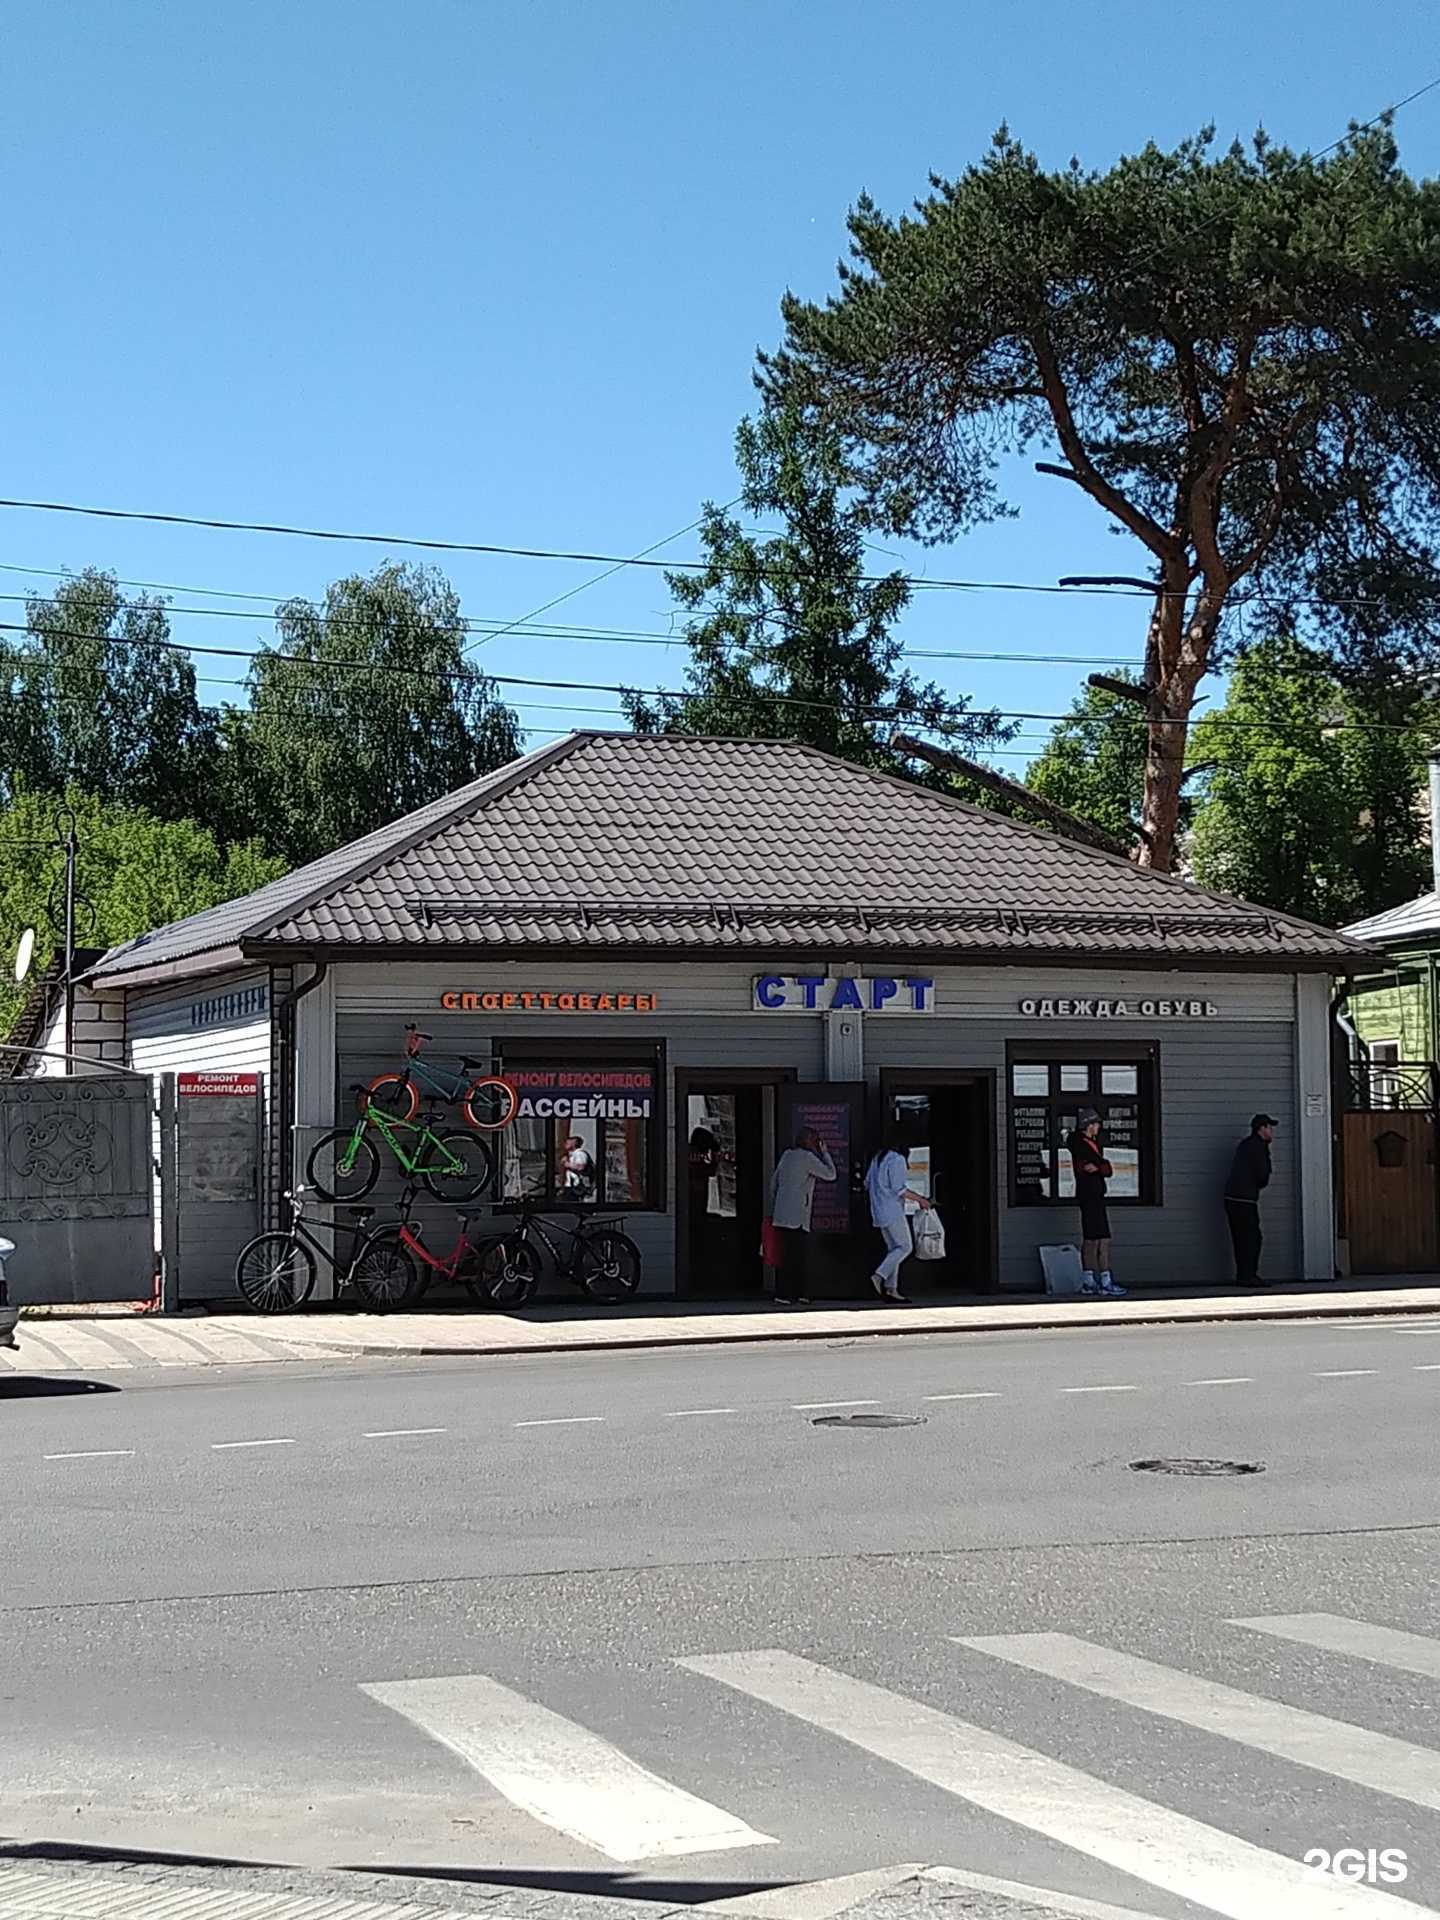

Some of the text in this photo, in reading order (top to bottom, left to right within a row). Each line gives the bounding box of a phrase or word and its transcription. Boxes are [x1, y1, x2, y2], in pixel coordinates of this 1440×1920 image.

[441, 992, 657, 1010] СПОРТТОВАРЫ
[756, 976, 933, 1010] СТАРТ
[1021, 1000, 1218, 1017] ОДЕЖДА ОБУВЬ
[198, 1074, 239, 1082] РЕМОНТ
[559, 1073, 652, 1089] ВЕЛОСИПЕДОВ
[180, 1084, 256, 1094] ВЕЛОСИПЕДОВ
